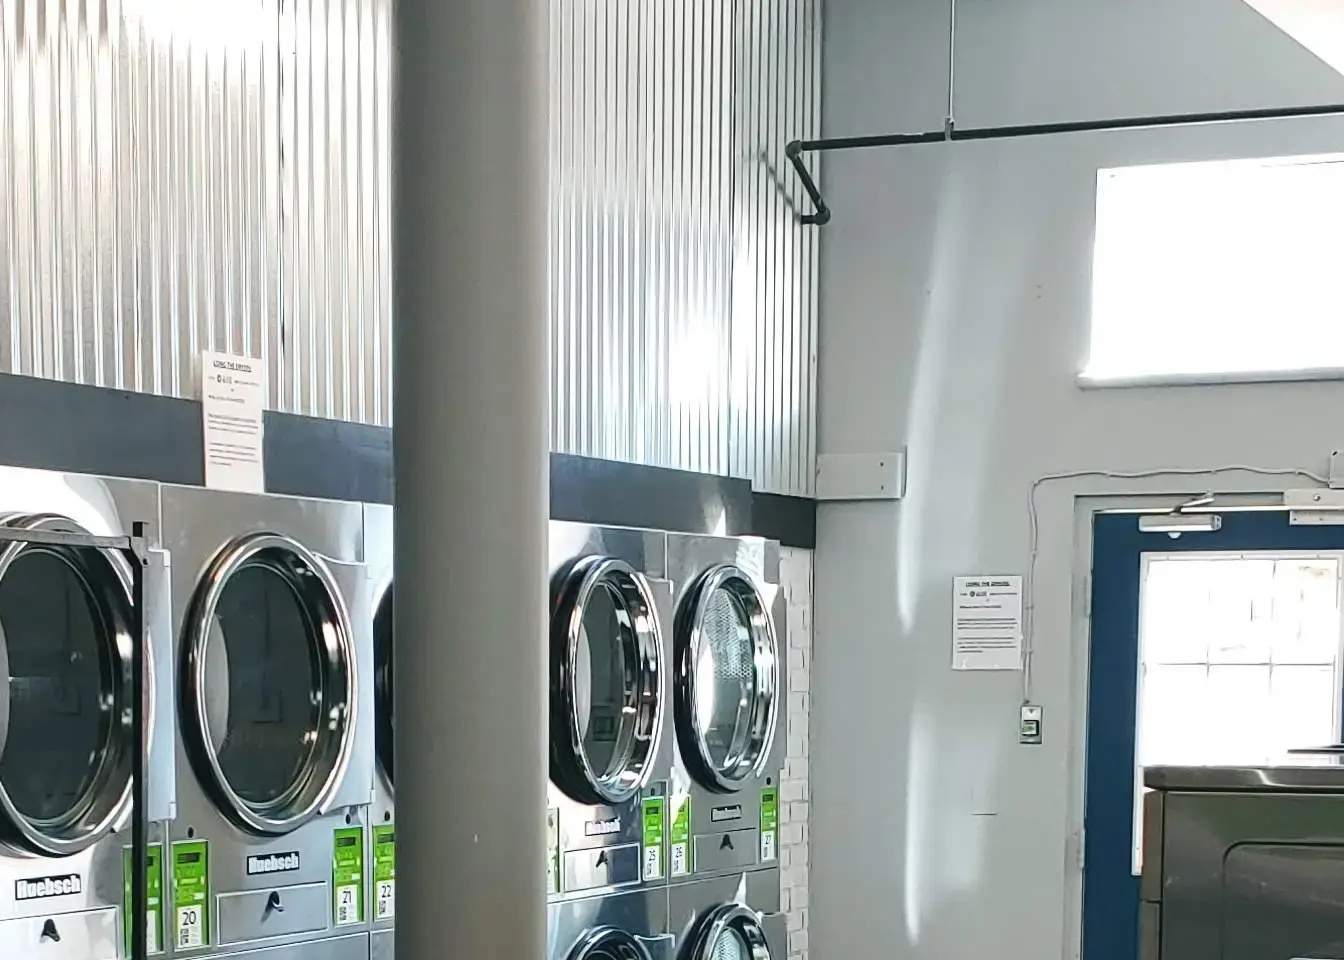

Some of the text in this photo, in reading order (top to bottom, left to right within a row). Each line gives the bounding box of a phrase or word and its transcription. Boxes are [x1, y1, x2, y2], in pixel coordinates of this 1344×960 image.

[16, 875, 80, 899] Huebsch
[381, 885, 392, 898] 22
[182, 910, 197, 926] 20
